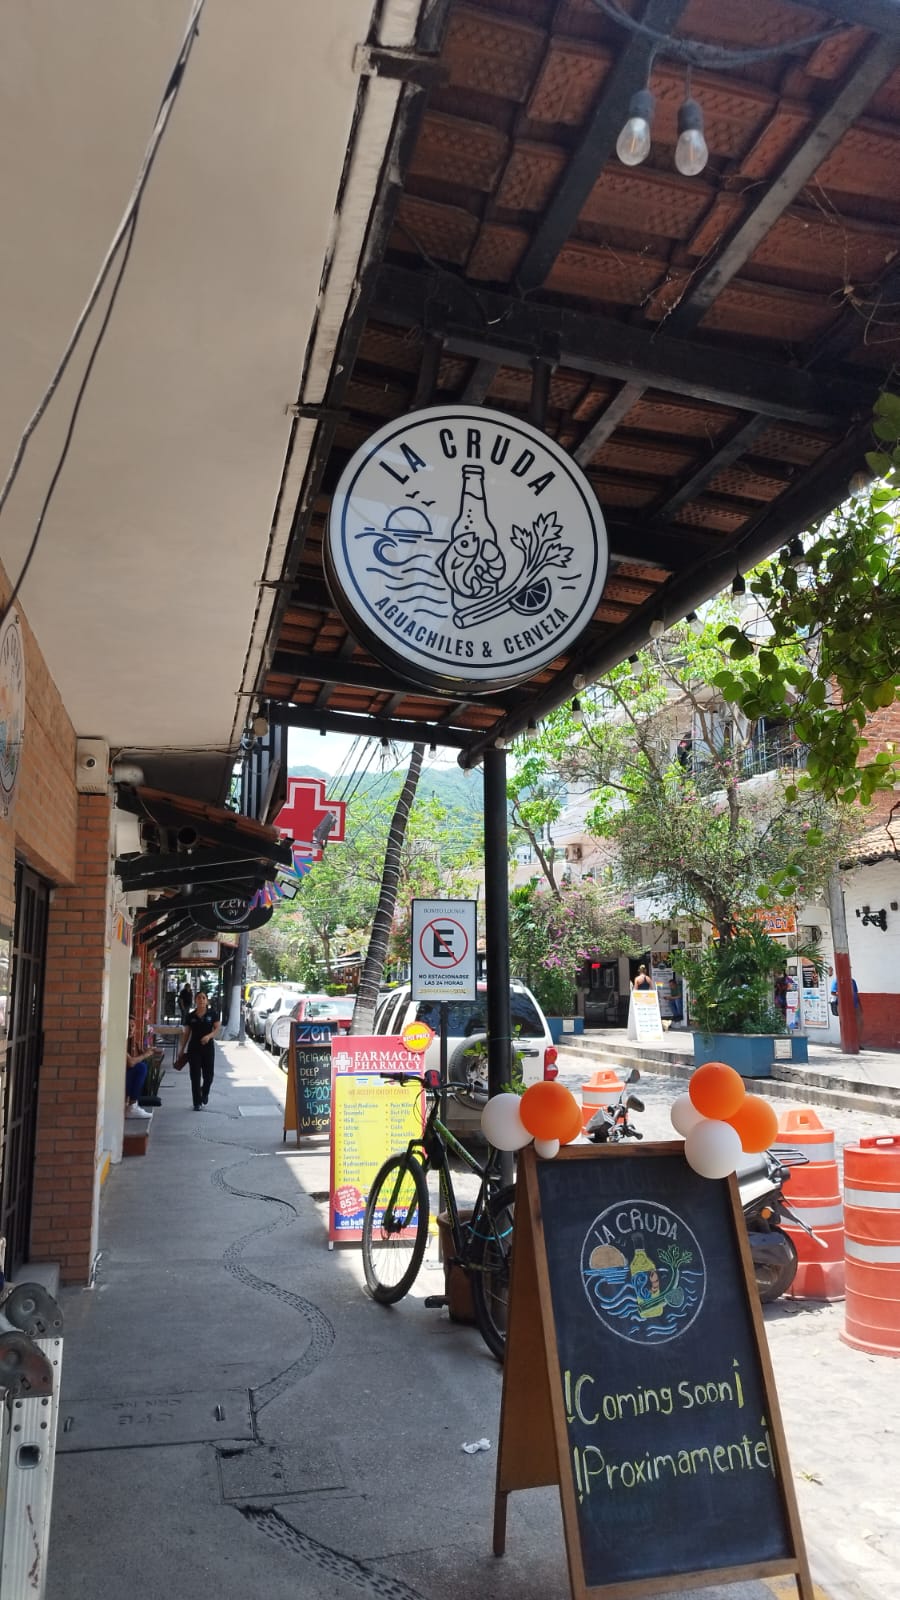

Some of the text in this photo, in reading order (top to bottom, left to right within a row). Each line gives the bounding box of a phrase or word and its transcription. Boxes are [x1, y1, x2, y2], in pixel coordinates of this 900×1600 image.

[379, 427, 556, 497] LA CRUDA
[374, 595, 570, 659] AGUACHILES & CERVEZA
[433, 929, 455, 957] E
[354, 1051, 421, 1061] FARMACIA
[354, 1061, 421, 1070] PHARMACY
[594, 1208, 678, 1245] LA CRUDA
